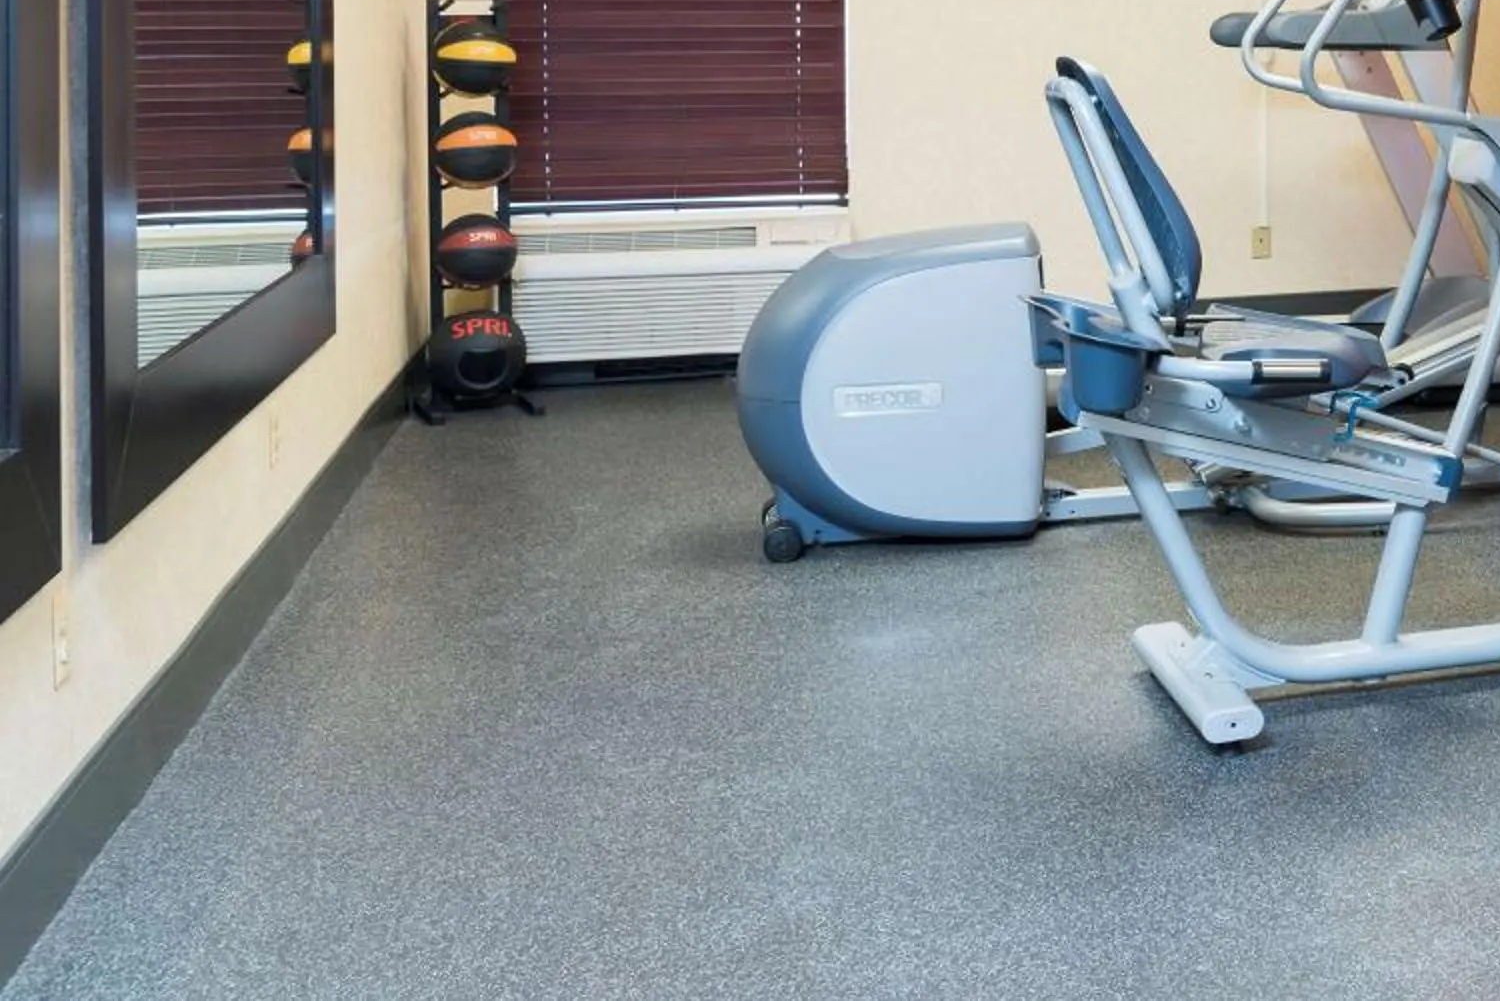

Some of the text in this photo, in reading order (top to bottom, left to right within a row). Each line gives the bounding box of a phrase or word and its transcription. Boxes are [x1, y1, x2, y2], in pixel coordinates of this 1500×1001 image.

[467, 231, 498, 244] SPRI
[451, 318, 509, 339] SPRI
[843, 389, 923, 411] PRECOR
